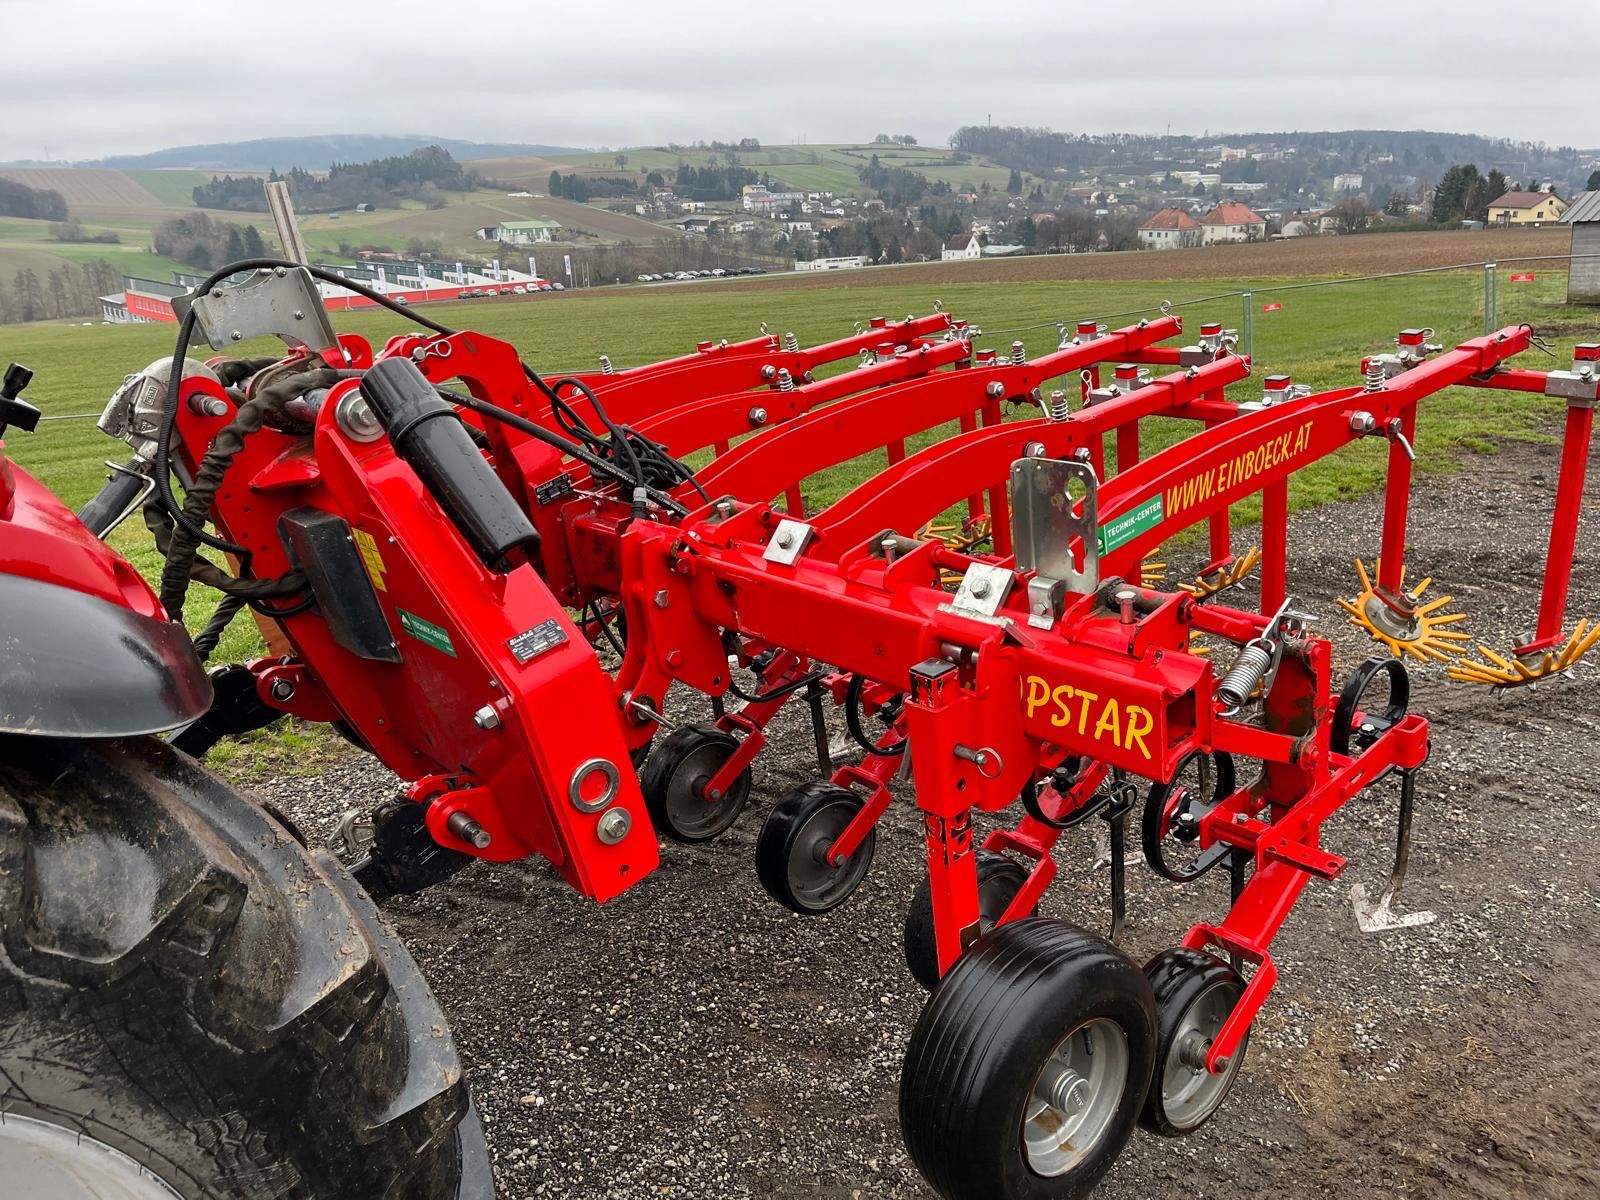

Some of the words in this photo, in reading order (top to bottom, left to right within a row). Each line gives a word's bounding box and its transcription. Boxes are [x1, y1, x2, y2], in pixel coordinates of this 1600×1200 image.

[1166, 421, 1313, 519] WWW.EINBOECK.AT
[1107, 501, 1161, 537] TECHNIK-CENTER
[1019, 674, 1154, 760] PSTAR
